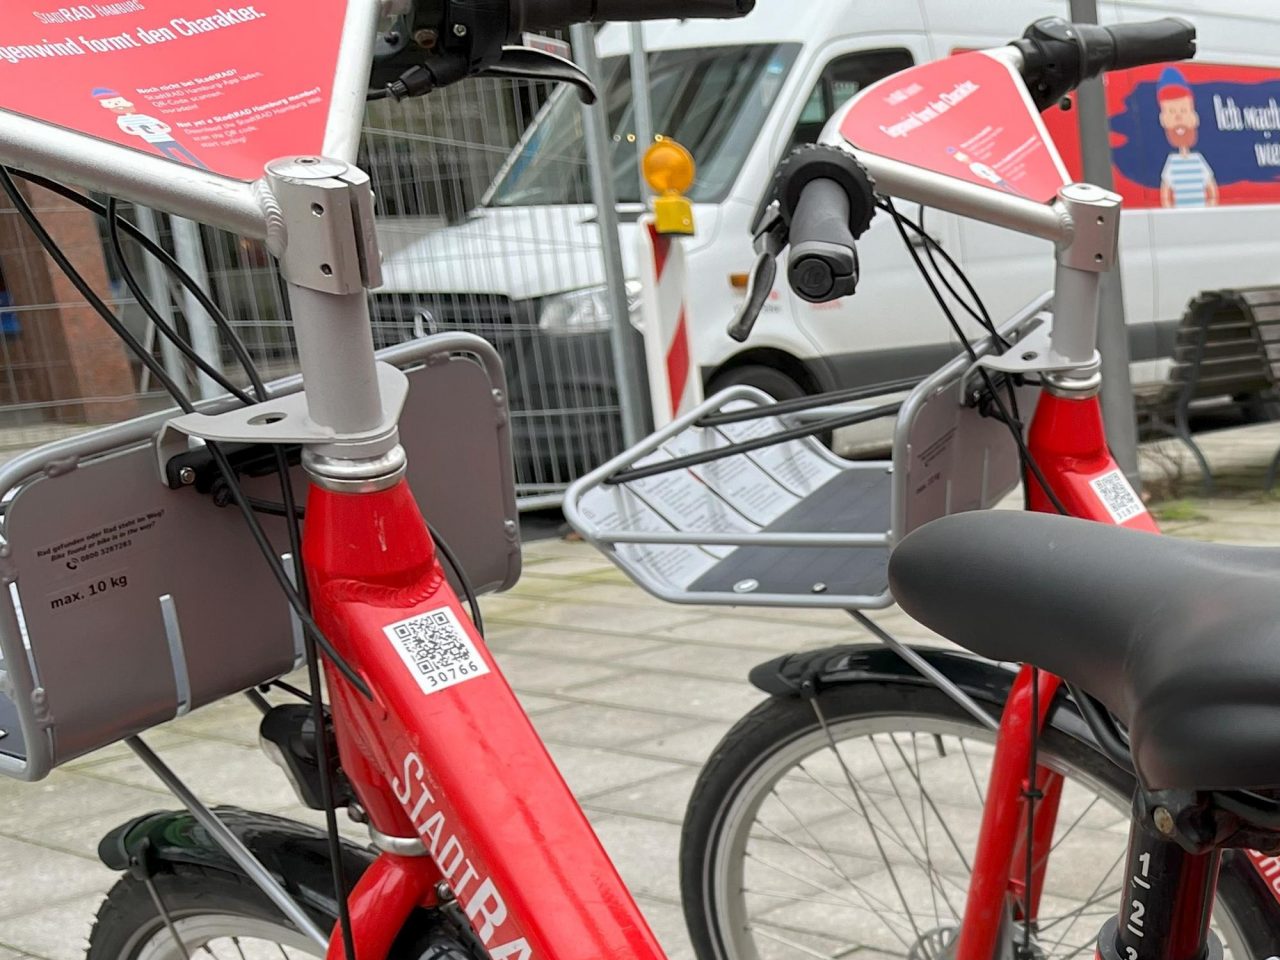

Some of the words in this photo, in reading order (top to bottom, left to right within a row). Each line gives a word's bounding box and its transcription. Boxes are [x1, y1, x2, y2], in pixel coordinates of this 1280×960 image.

[0, 37, 86, 63] genwind
[78, 32, 142, 53] formt
[136, 27, 177, 45] den
[170, 6, 267, 36] Charakter.
[50, 592, 85, 609] max.
[89, 581, 107, 596] 10
[110, 575, 128, 588] kg
[427, 661, 478, 687] 30766
[1139, 852, 1150, 877] 1
[1129, 900, 1145, 927] 2
